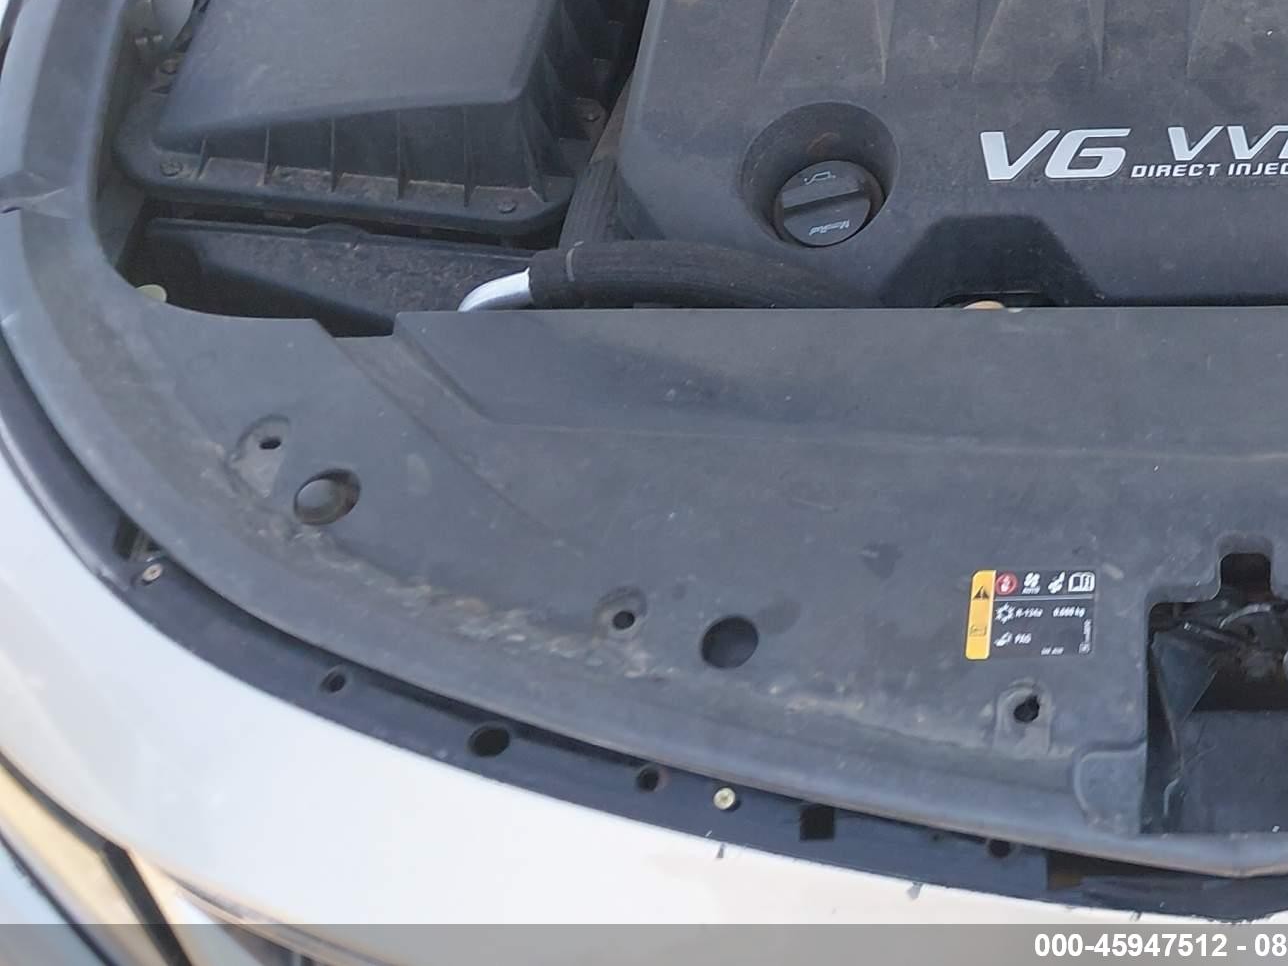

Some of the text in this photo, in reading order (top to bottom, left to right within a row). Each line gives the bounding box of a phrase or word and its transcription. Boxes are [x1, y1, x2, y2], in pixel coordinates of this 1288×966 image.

[980, 128, 1132, 181] V6
[1131, 163, 1221, 178] DIRECT
[1021, 587, 1041, 595] AUTO
[1074, 606, 1086, 618] kg
